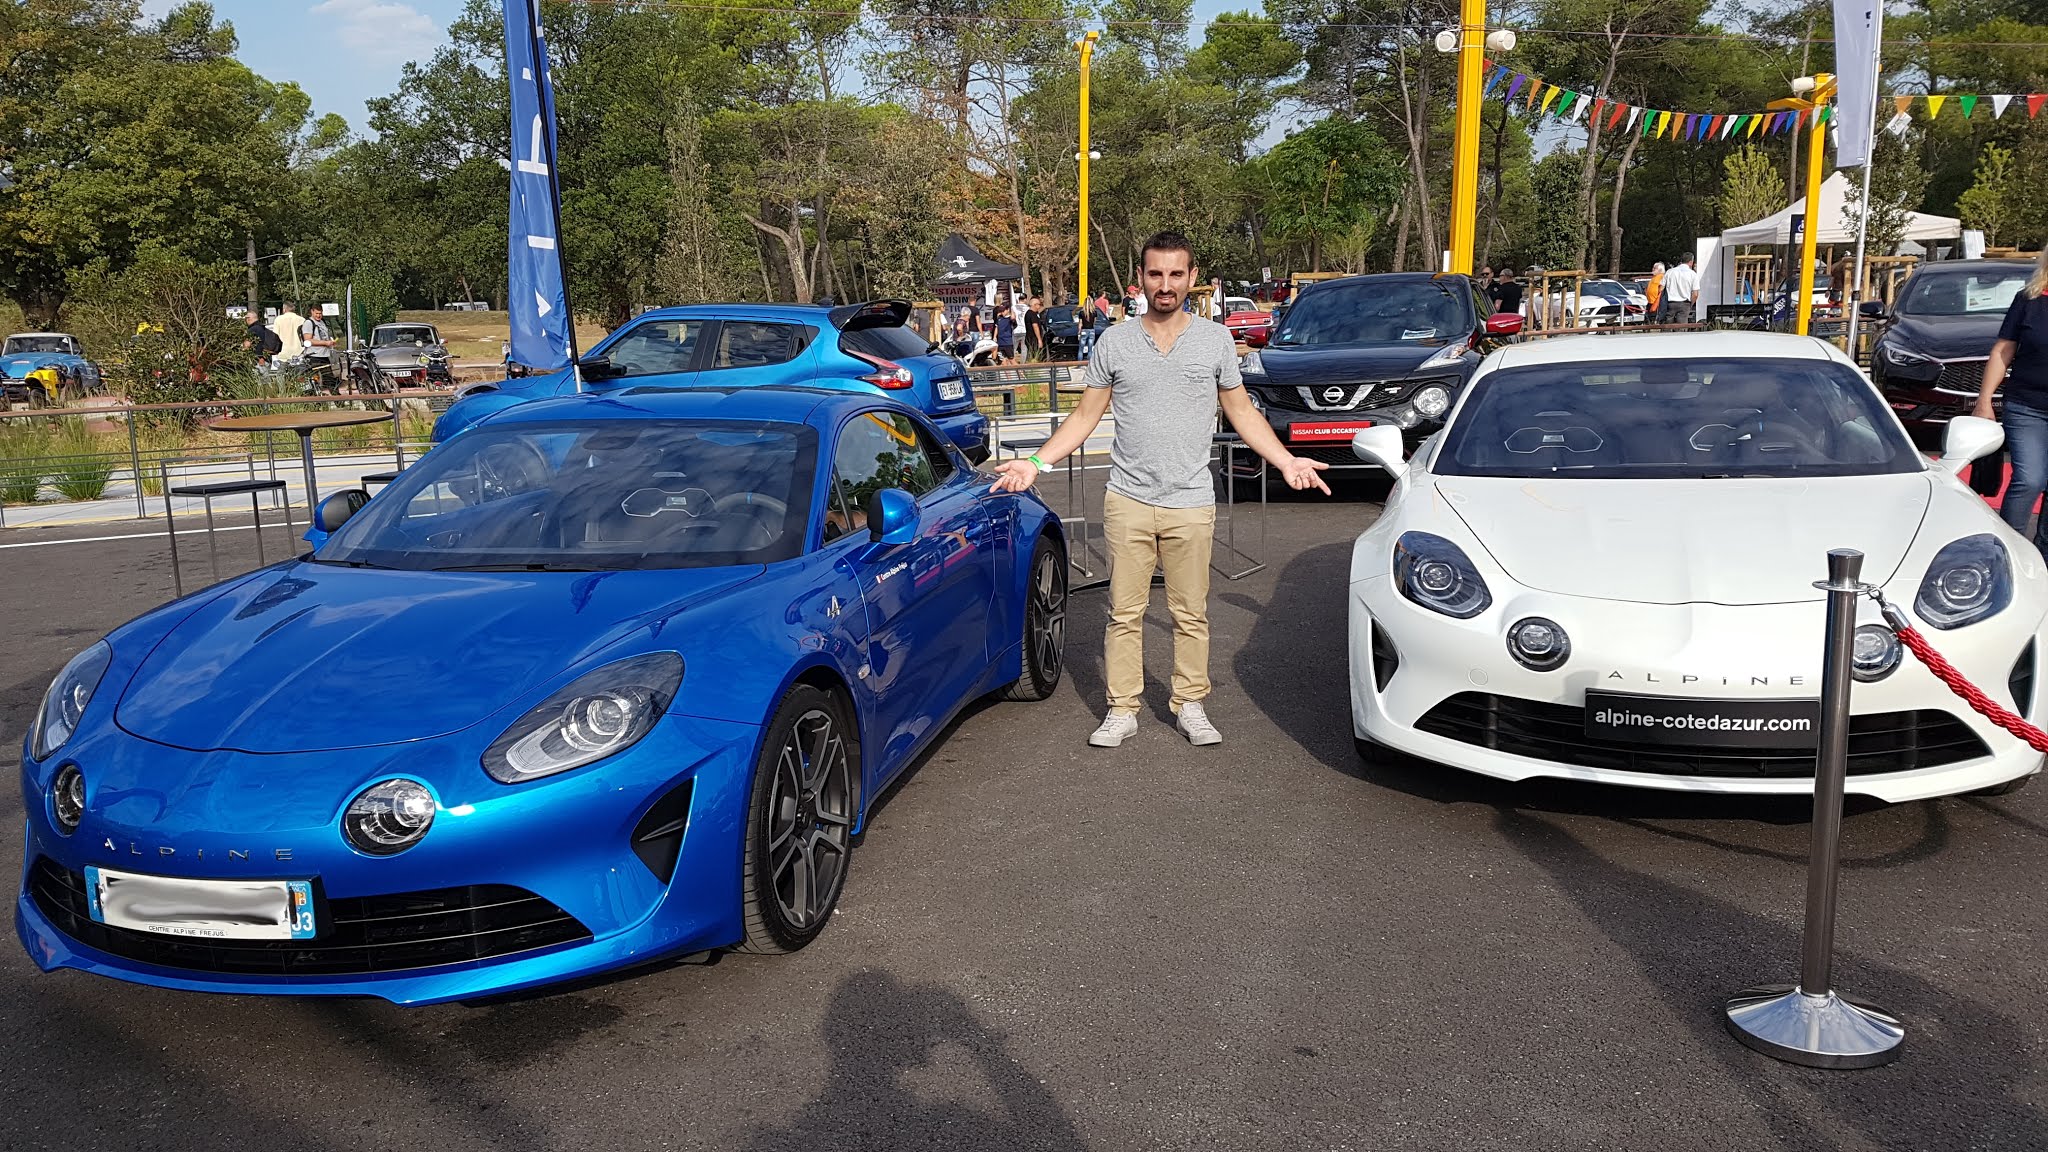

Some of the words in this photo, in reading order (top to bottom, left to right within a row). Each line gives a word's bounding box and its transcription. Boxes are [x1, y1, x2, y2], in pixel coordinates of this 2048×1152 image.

[1608, 670, 1804, 686] ALPINE
[1595, 708, 1811, 731] alpine-cotedazur.com
[104, 837, 293, 861] ALPINE
[148, 925, 170, 934] CENTRE
[173, 928, 197, 936] ALPINE
